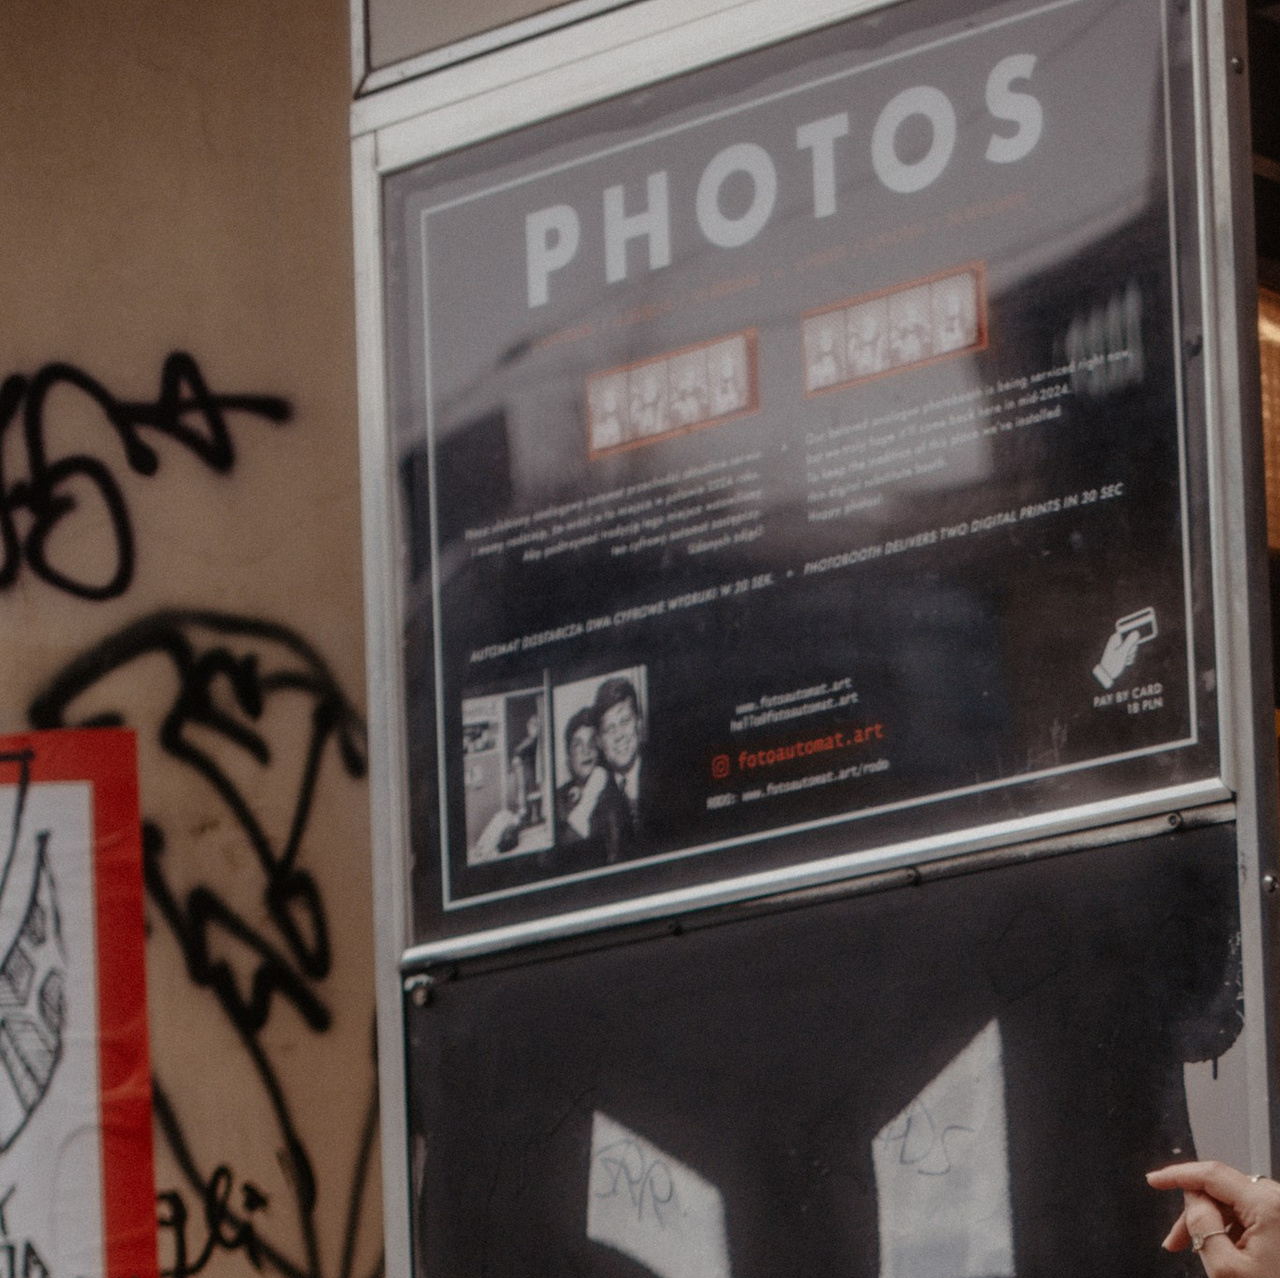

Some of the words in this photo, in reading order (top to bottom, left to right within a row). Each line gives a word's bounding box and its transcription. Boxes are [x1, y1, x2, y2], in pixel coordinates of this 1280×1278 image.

[524, 53, 1045, 309] PHOTOS
[803, 544, 883, 576] PHOTOBOOTH
[883, 530, 938, 556] DELIVERS
[939, 522, 968, 541] TWO
[970, 509, 1016, 533] DIGITAL
[1018, 498, 1060, 520] PRINTS
[1062, 493, 1079, 509] IN
[1080, 488, 1098, 505] 30
[1098, 481, 1124, 500] SEC
[734, 676, 852, 714] www.fotoautomat.art
[1092, 694, 1113, 707] PAY
[1114, 691, 1128, 703] BY
[1131, 683, 1163, 698] CARD
[1141, 697, 1163, 711] PLN
[738, 720, 883, 770] fotoautomat.art
